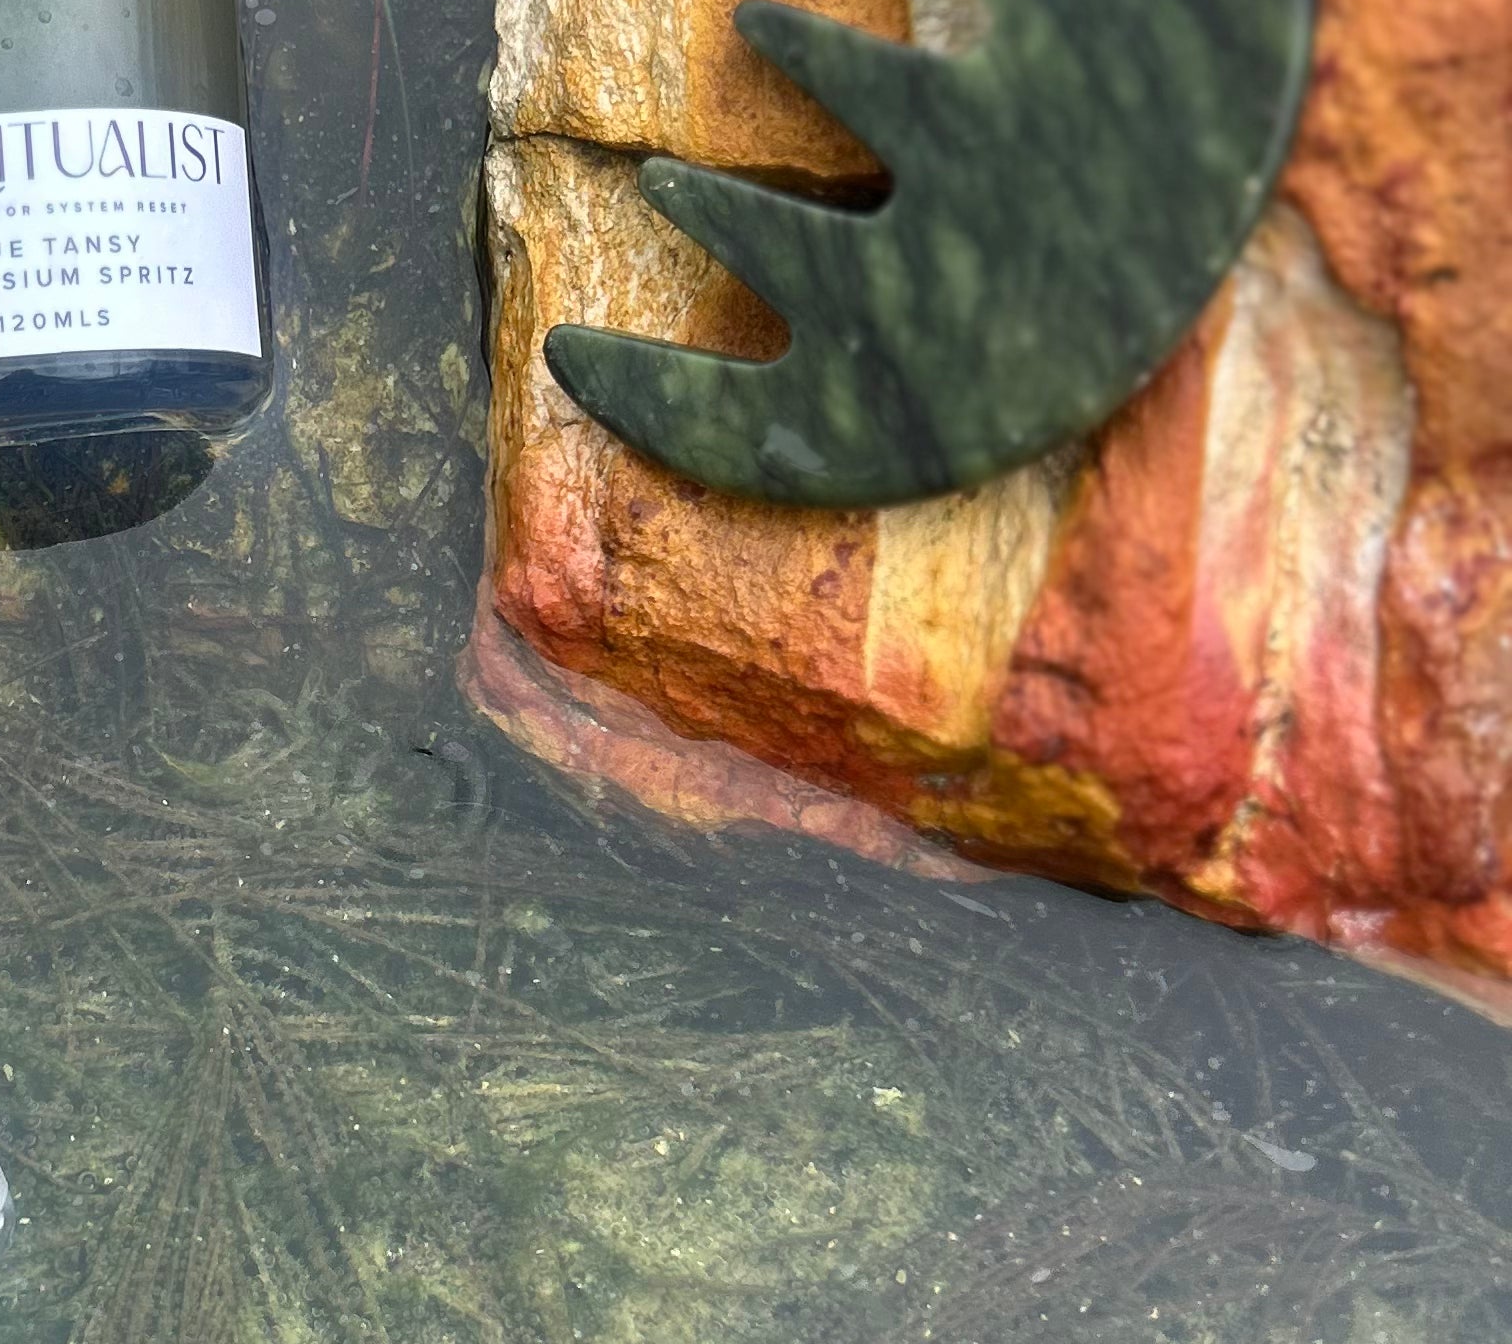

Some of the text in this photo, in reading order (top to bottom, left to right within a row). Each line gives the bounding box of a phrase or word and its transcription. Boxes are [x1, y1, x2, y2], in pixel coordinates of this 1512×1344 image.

[46, 200, 125, 215] SYSTEM
[137, 201, 188, 214] RESET
[43, 234, 143, 256] TANSY
[99, 266, 195, 286] SPRITZ
